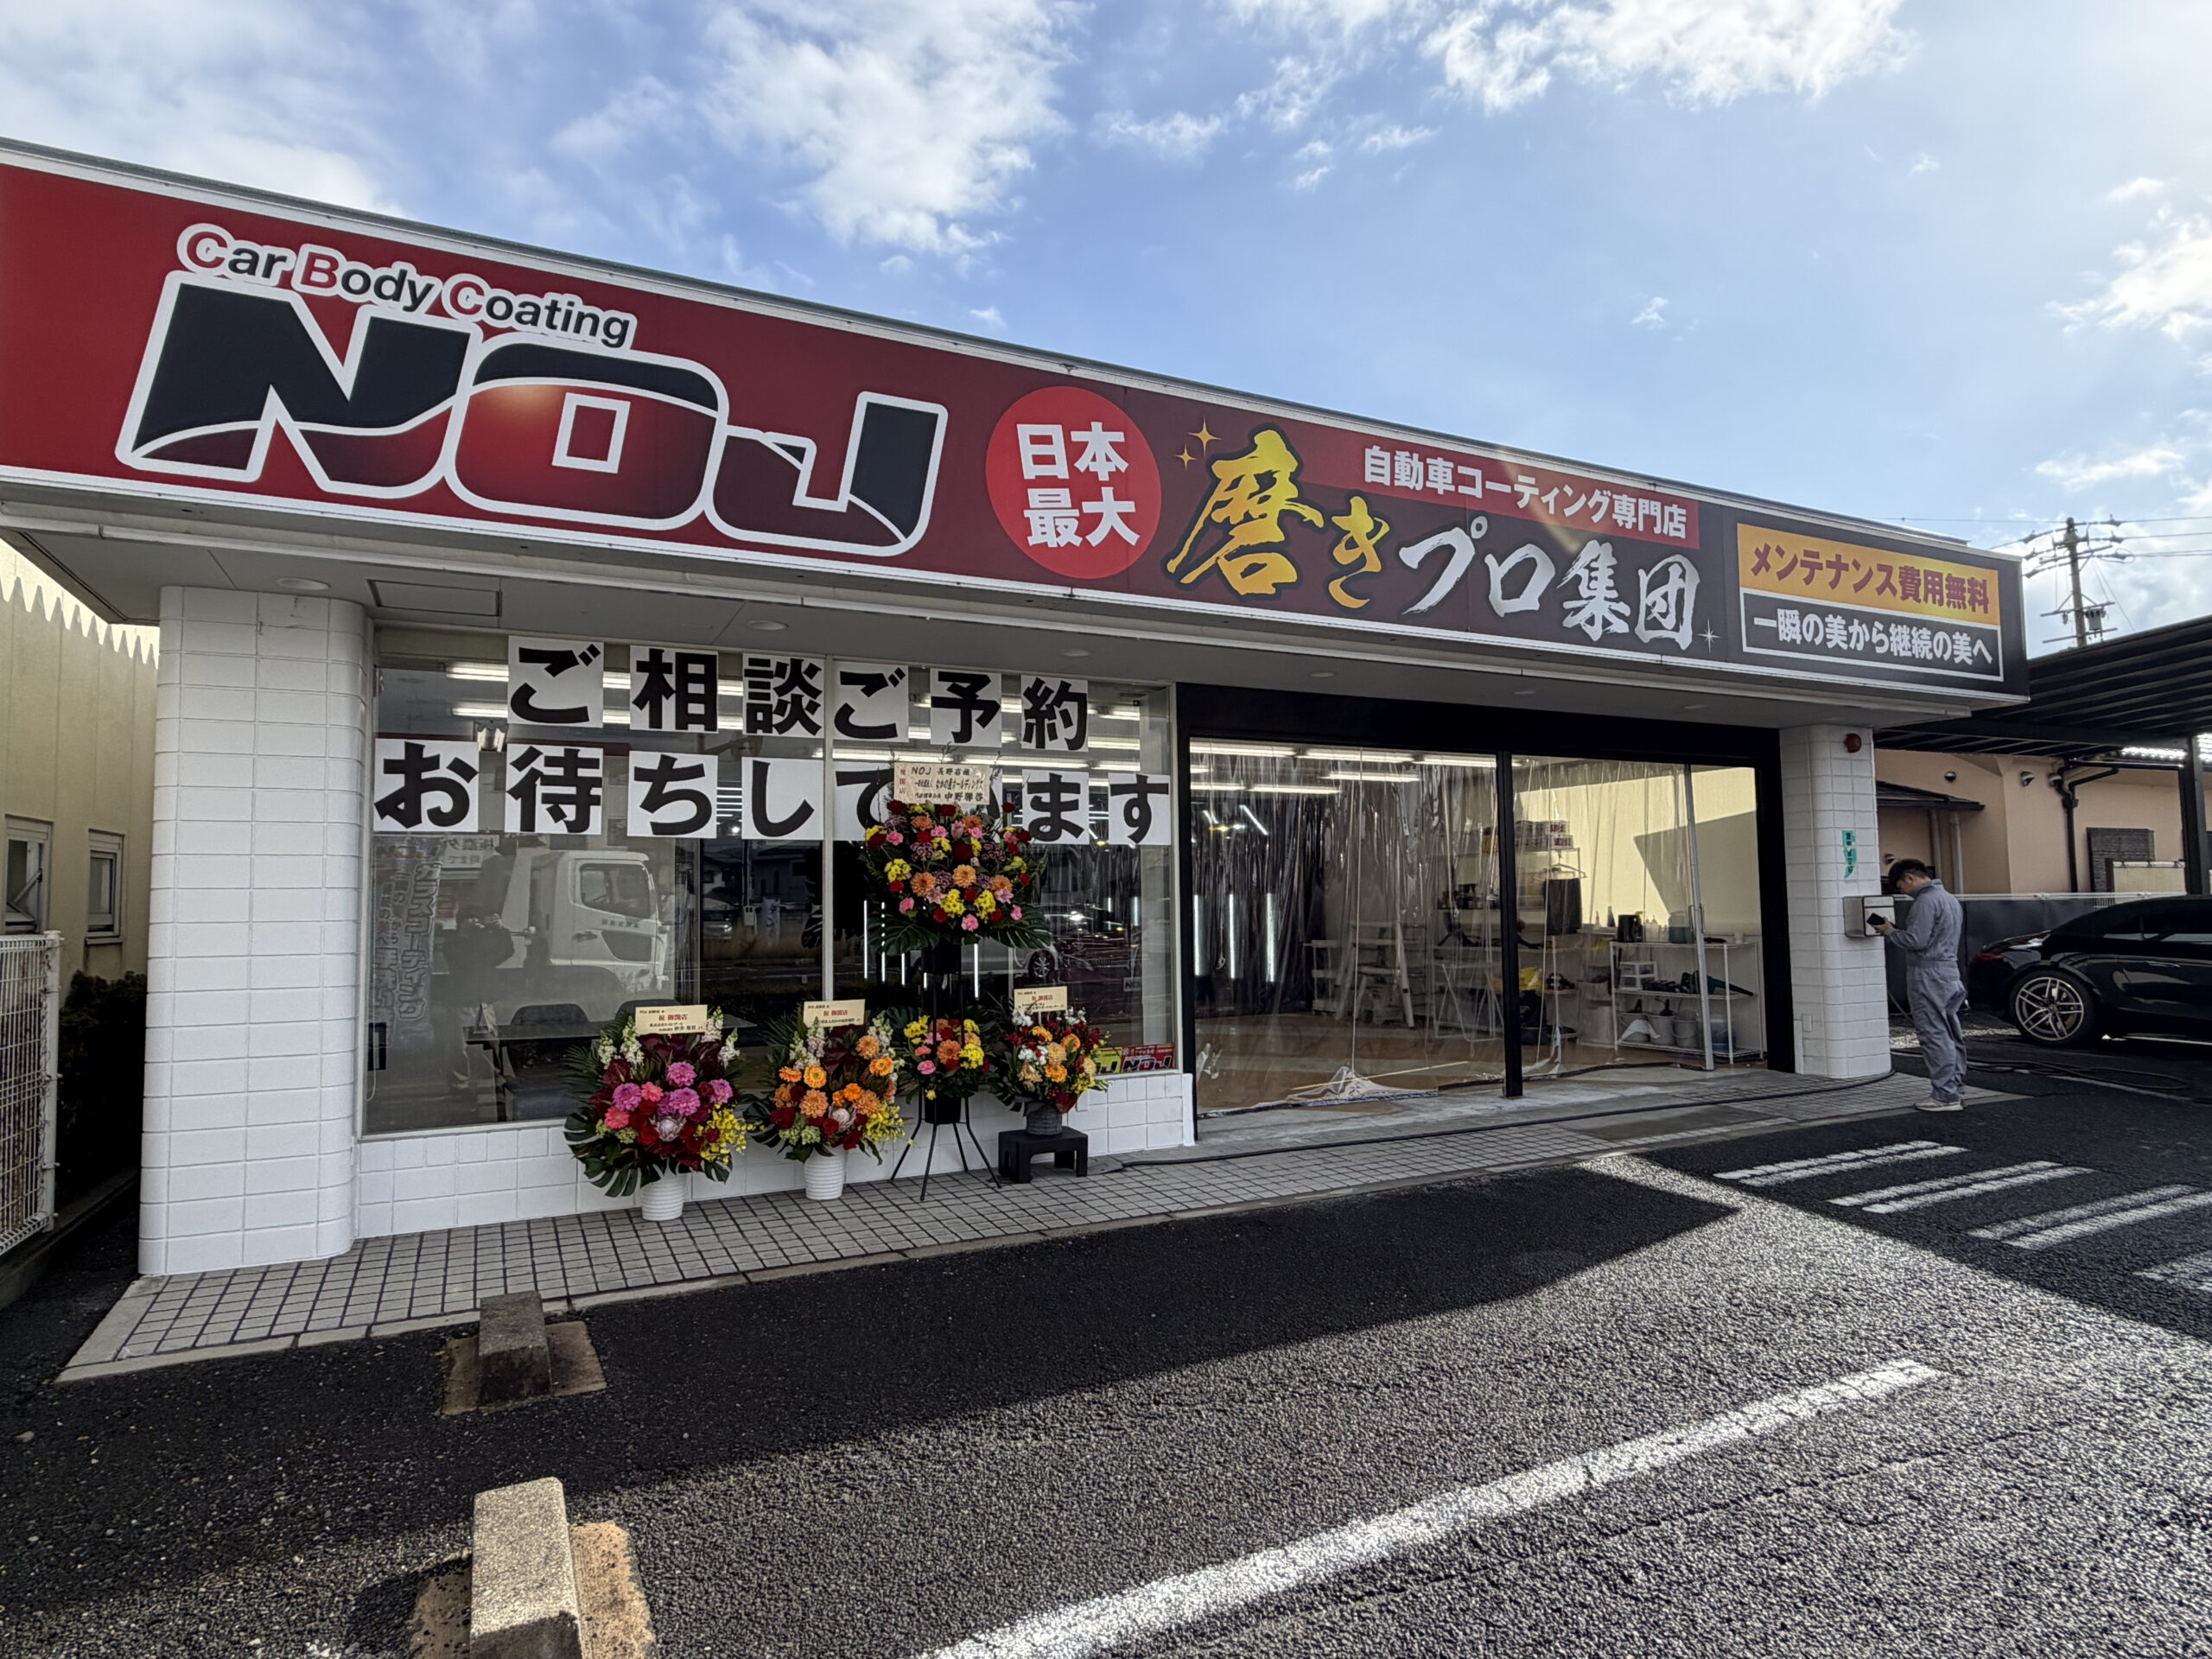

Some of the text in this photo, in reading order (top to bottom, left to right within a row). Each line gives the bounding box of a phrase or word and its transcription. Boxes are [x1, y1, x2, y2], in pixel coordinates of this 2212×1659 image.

[181, 227, 632, 349] Car Body Coating
[116, 270, 948, 557] NOJ
[1016, 422, 1129, 481] 日本
[1023, 486, 1141, 549] 最大
[1363, 445, 1688, 539] 自動車コーティング専門店
[1166, 429, 1700, 652] 磨きプロ集団
[1751, 543, 1990, 614] メンテナンス費用無料
[1753, 607, 1993, 665] 一瞬の美から継続の美へ
[373, 741, 1169, 844] お待ちしてます
[912, 766, 931, 776] NOJ
[1122, 1055, 1173, 1072] NOJ
